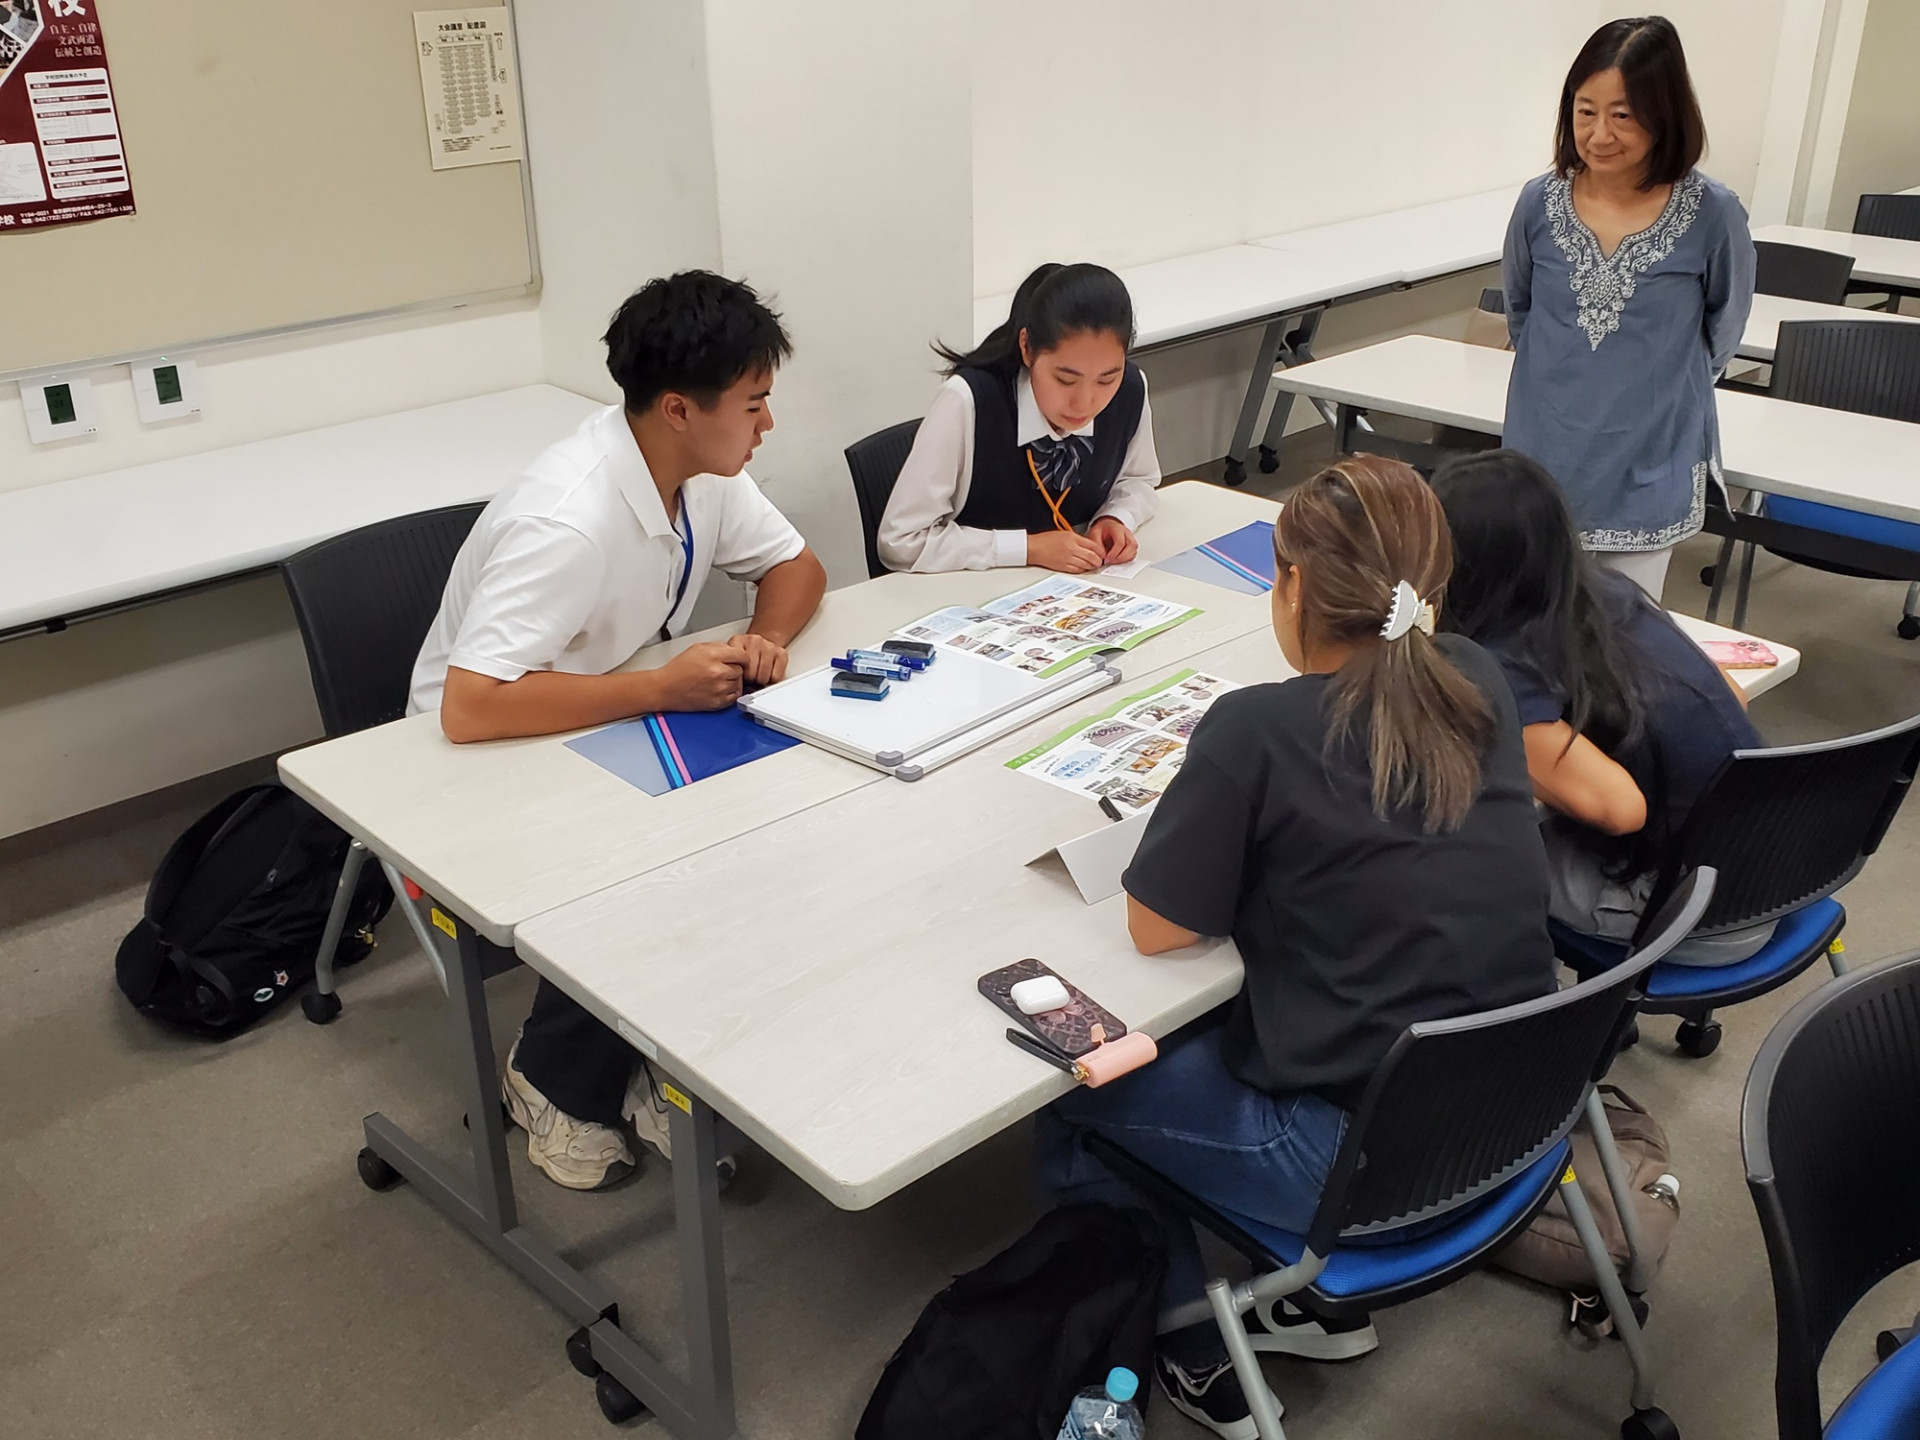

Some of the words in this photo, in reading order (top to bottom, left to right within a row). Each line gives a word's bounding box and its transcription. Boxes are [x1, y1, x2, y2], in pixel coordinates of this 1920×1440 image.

[58, 34, 95, 46] 文武両道
[55, 45, 102, 58] 伝統と創造
